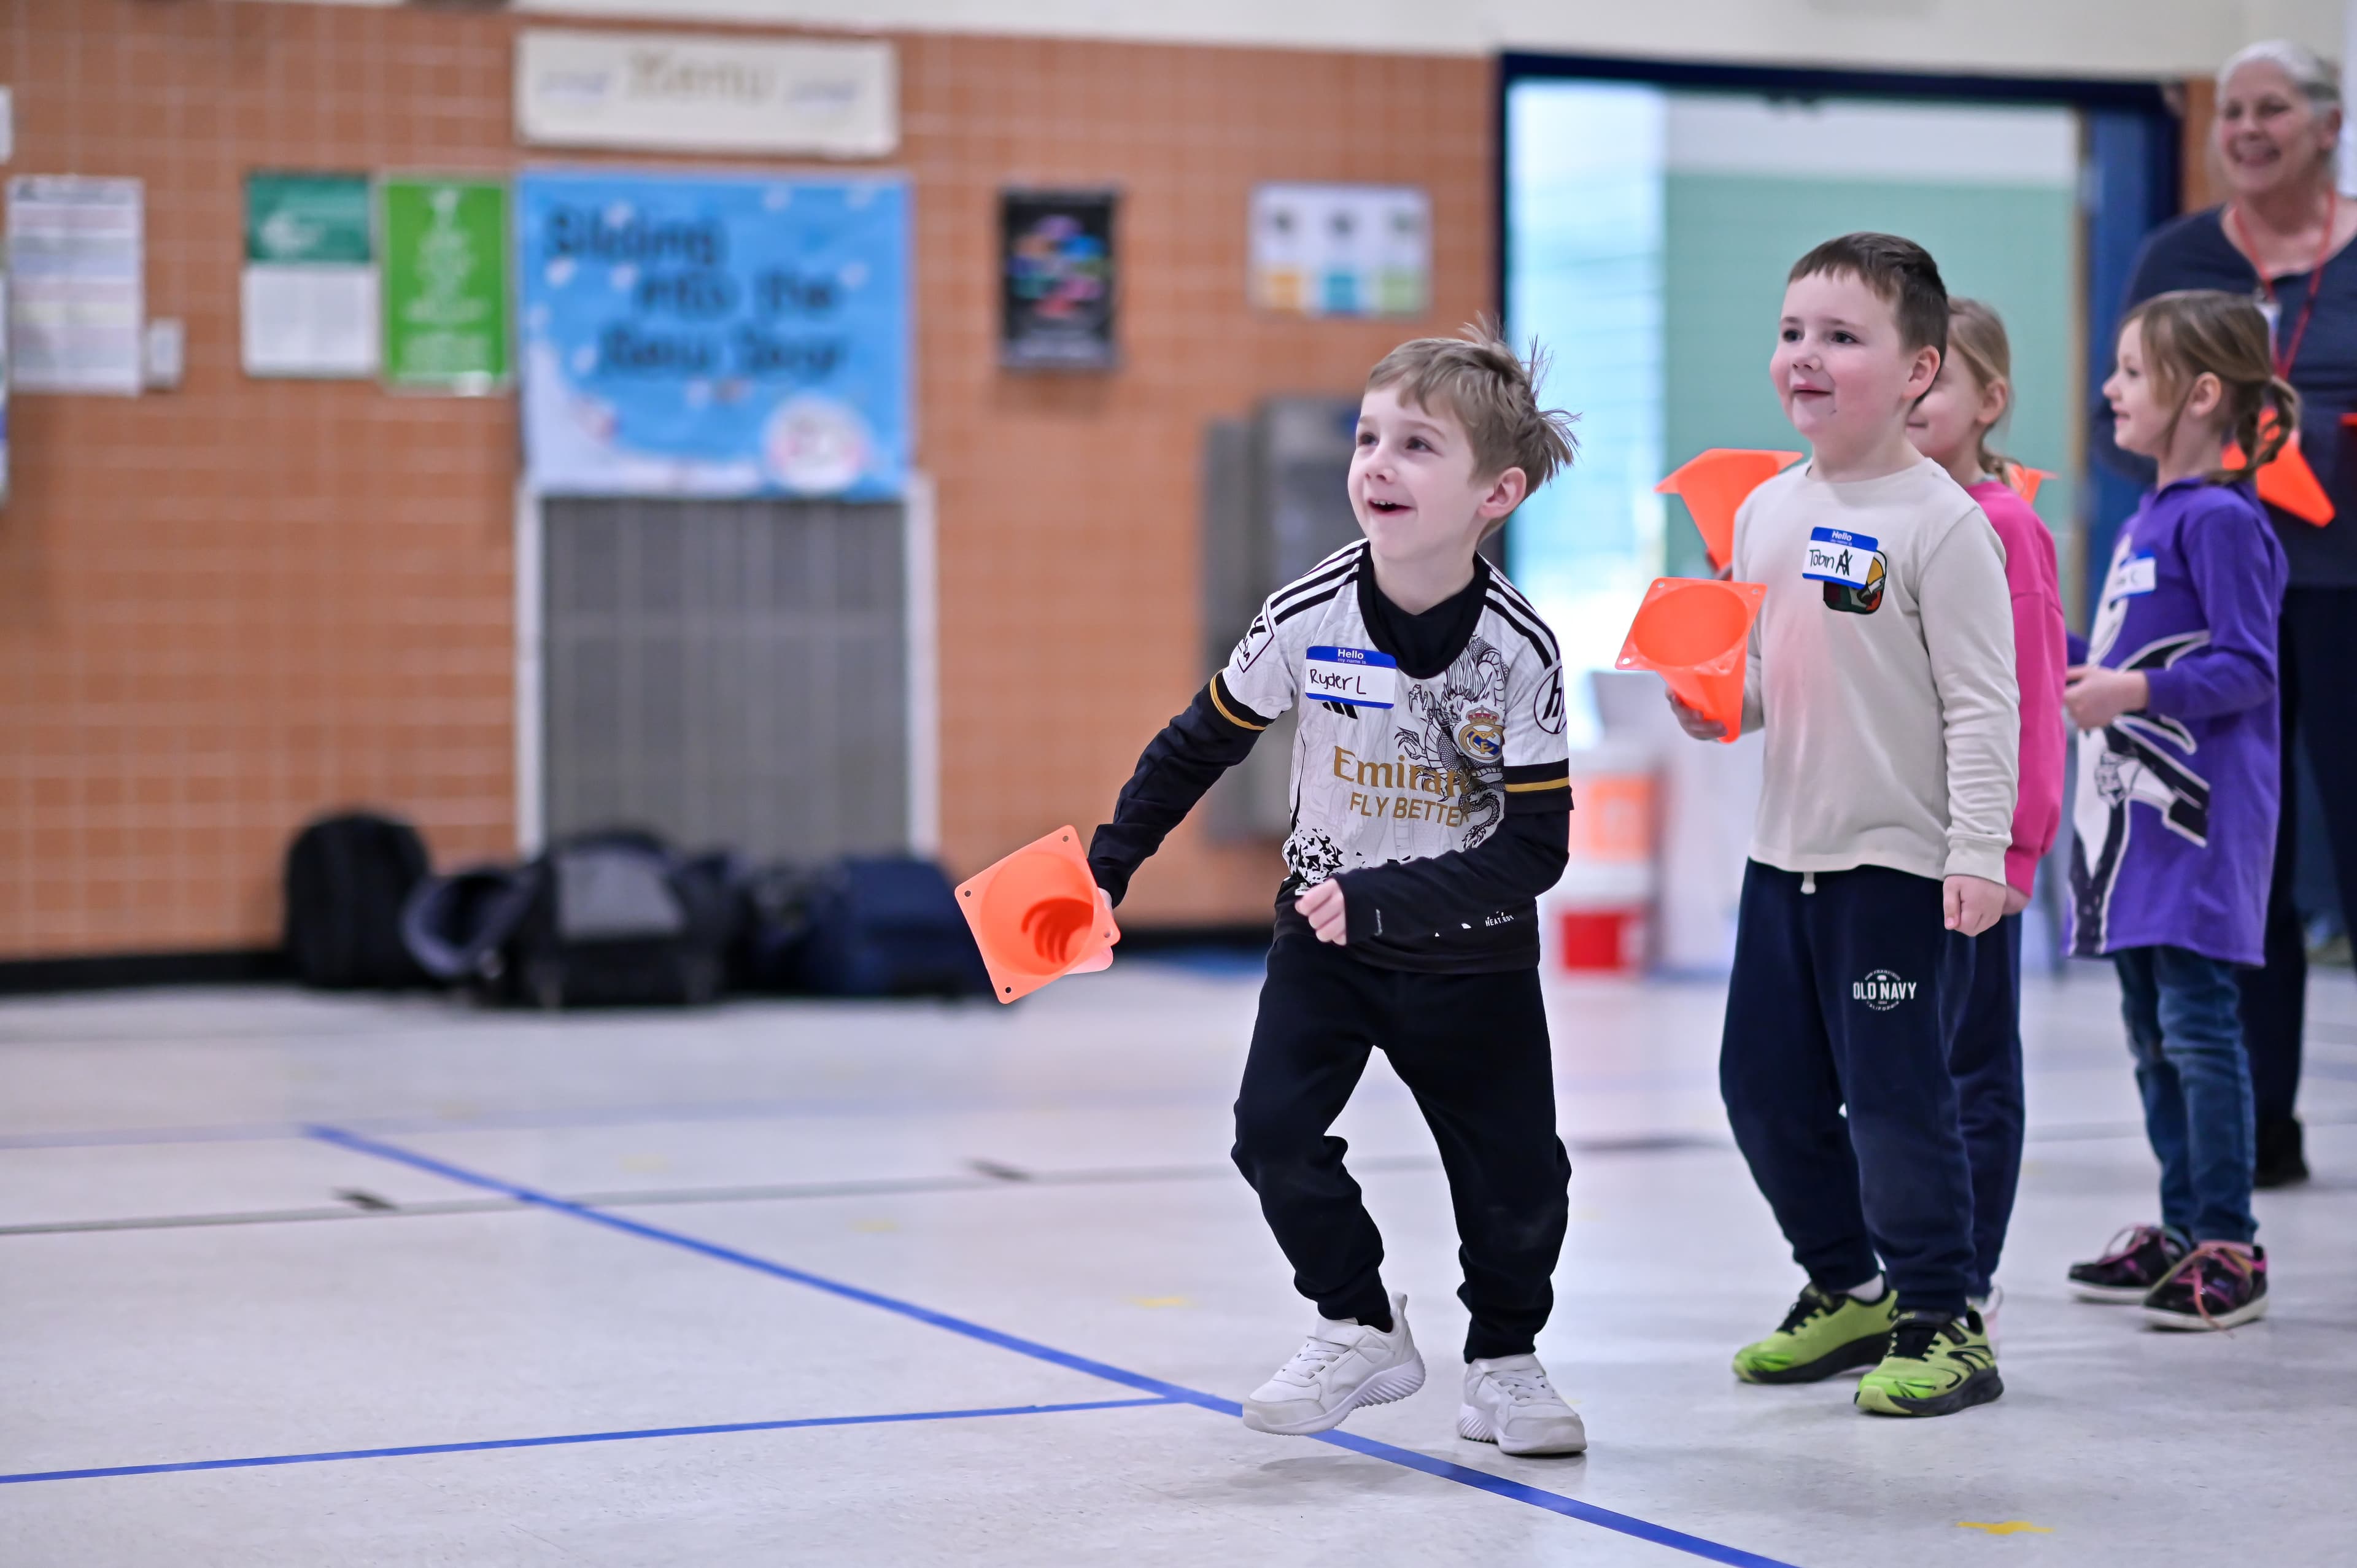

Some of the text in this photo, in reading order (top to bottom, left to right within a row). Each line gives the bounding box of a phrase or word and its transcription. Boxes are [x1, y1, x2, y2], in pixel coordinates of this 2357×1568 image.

[1832, 530, 1852, 541] Hello
[1809, 549, 1835, 569] Tobin
[1337, 649, 1364, 659] Hello
[1310, 669, 1366, 695] Ryder L
[1334, 746, 1472, 797] Emirat
[1350, 792, 1470, 827] FLY BETTER
[1853, 982, 1917, 1000] OLD NAVY
